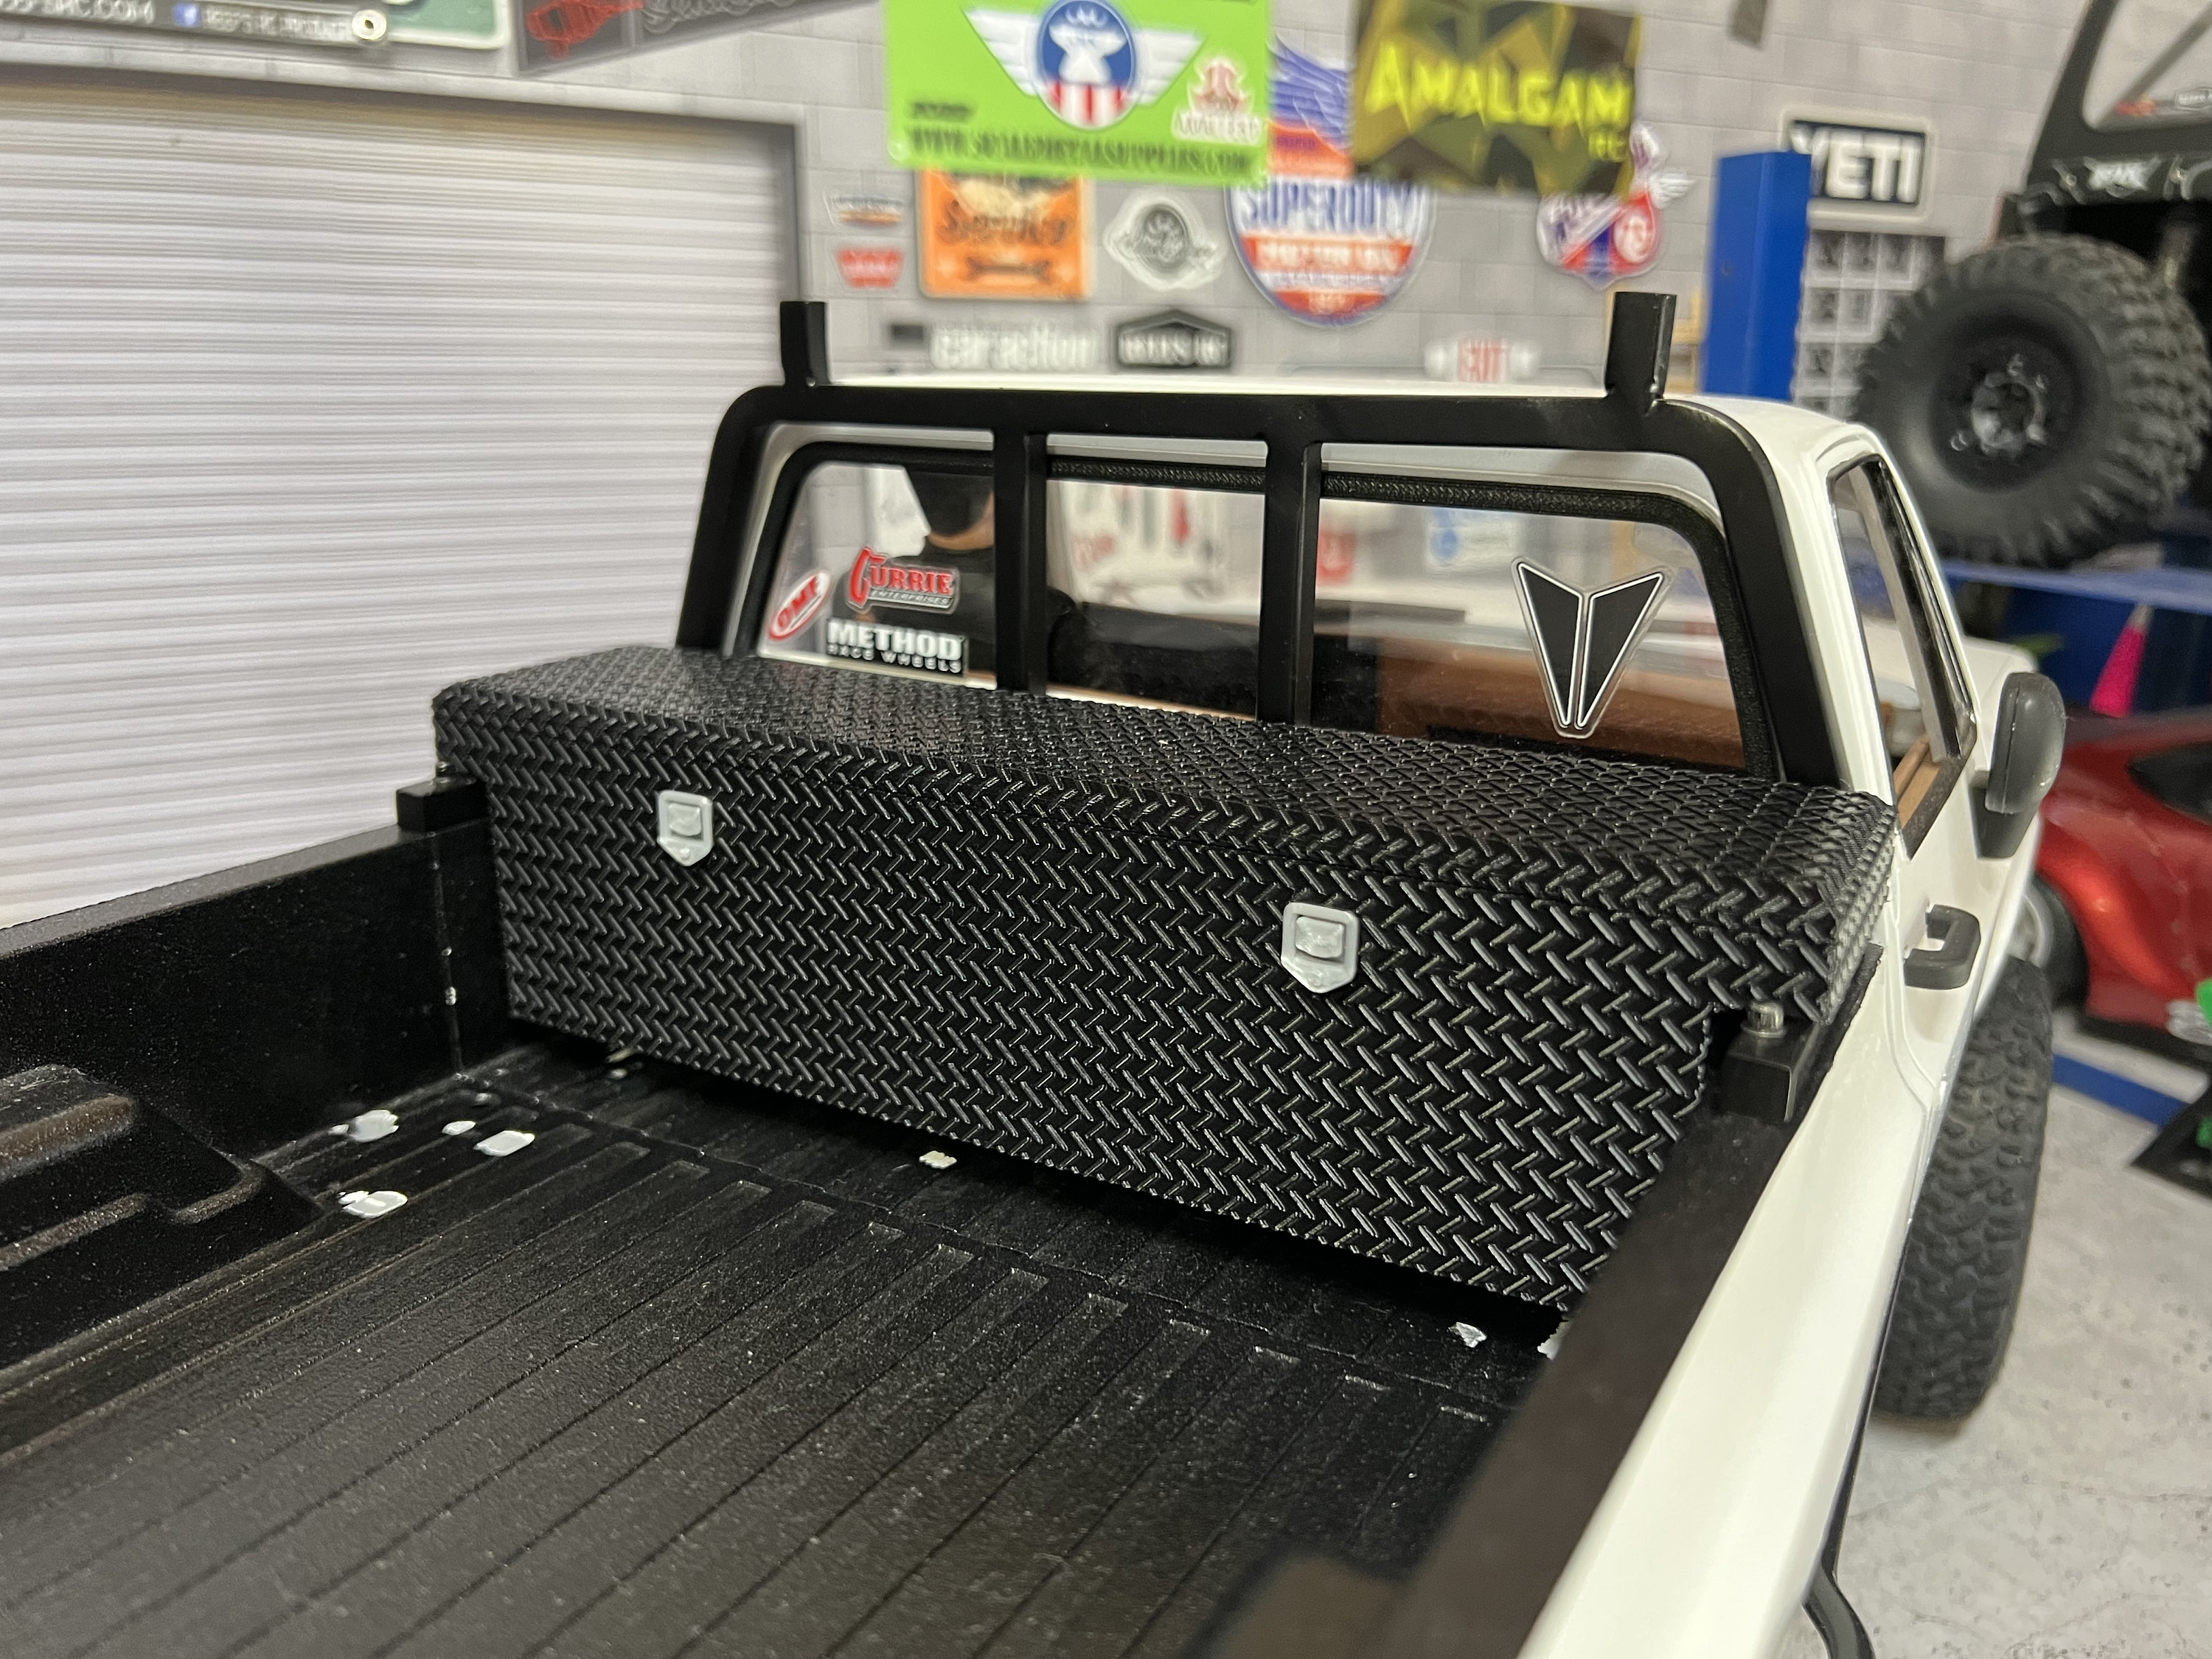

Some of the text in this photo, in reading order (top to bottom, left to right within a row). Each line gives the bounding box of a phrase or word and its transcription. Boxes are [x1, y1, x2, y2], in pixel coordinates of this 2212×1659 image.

[1364, 41, 1632, 136] AMALGAM
[1790, 123, 1919, 204] YETI
[850, 546, 954, 606] CURRIE
[870, 588, 950, 605] ENTERPRISES
[827, 619, 963, 661] METHOD
[827, 643, 962, 674] RACE WHEELS
